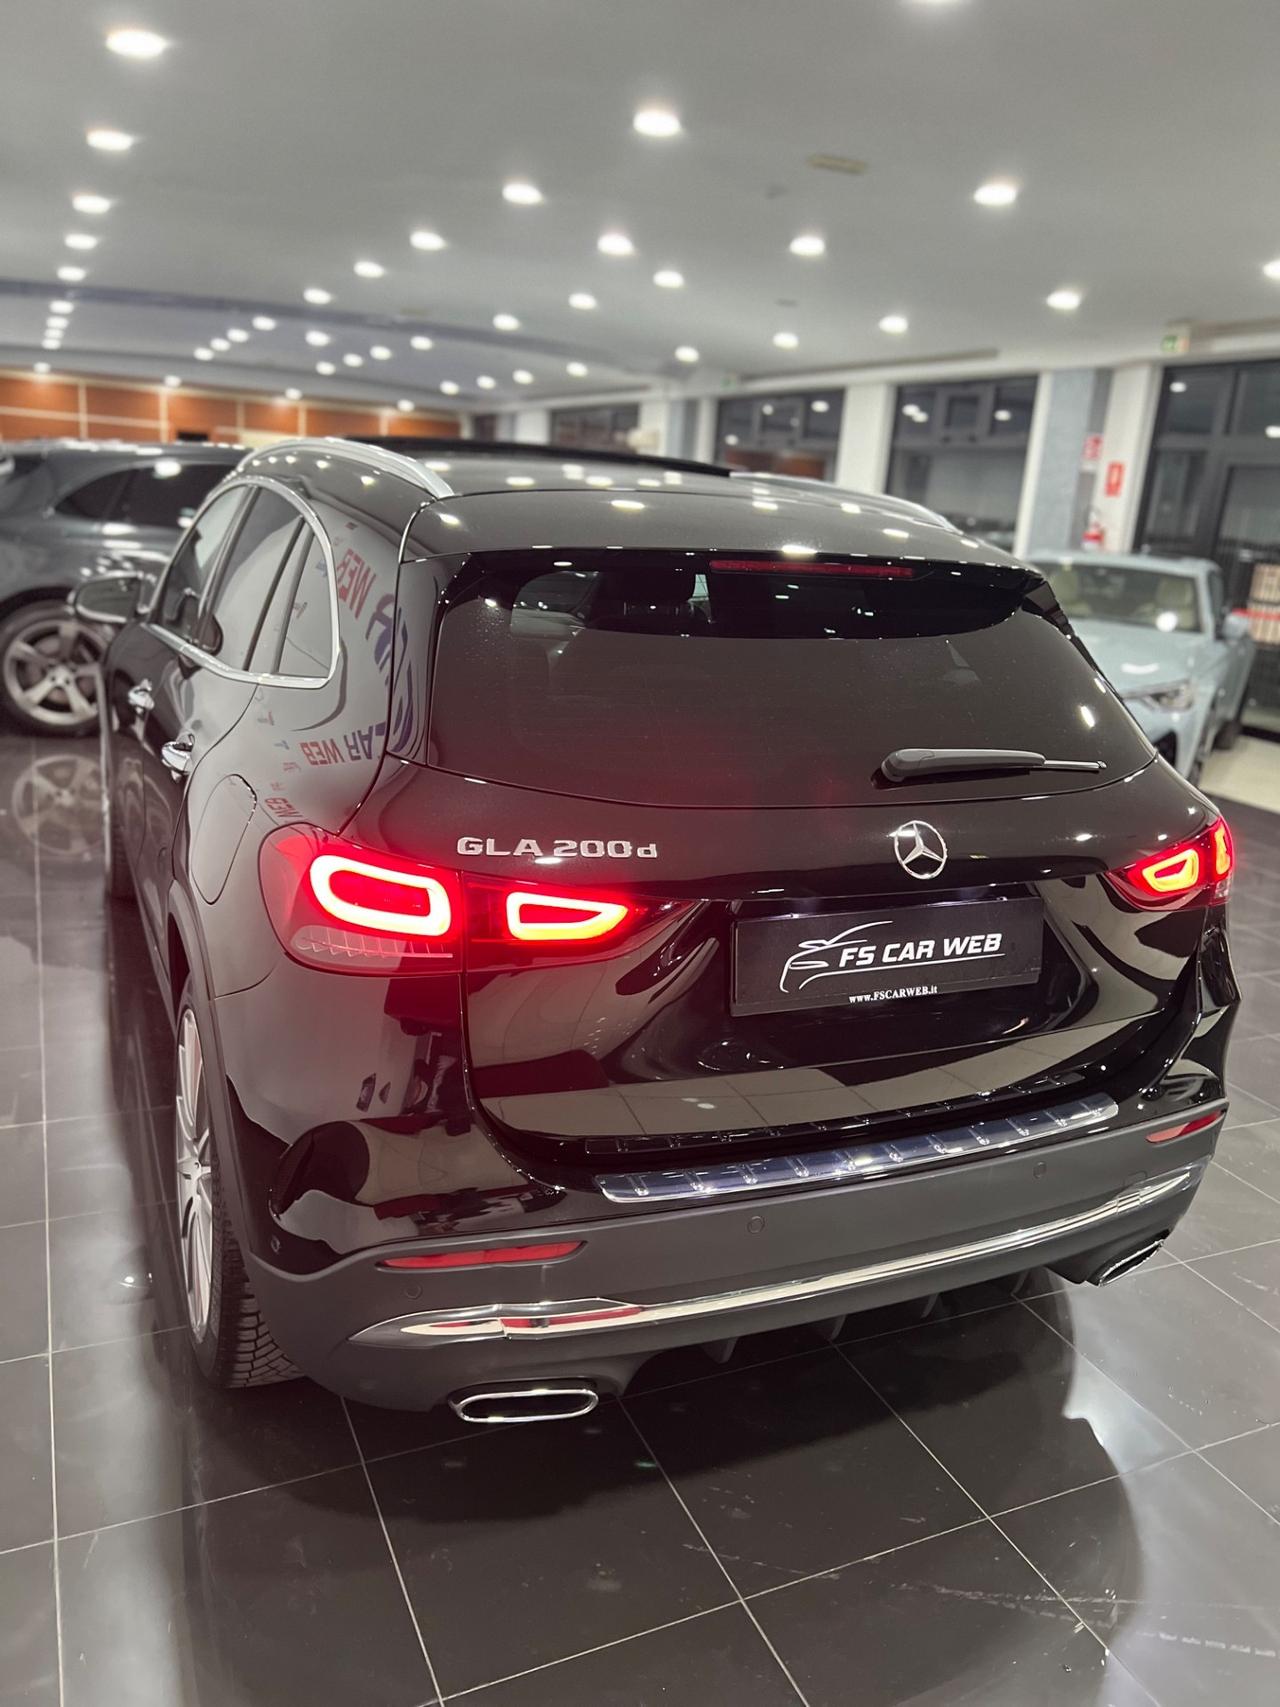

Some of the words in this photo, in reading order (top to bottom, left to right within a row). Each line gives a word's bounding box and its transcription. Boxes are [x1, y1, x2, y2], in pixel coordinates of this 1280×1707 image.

[457, 836, 543, 857] GLA
[838, 945, 877, 968] FS
[881, 939, 936, 963] CAR
[943, 932, 1003, 957] WEB
[849, 985, 938, 1003] www.FSCARWEB.it
